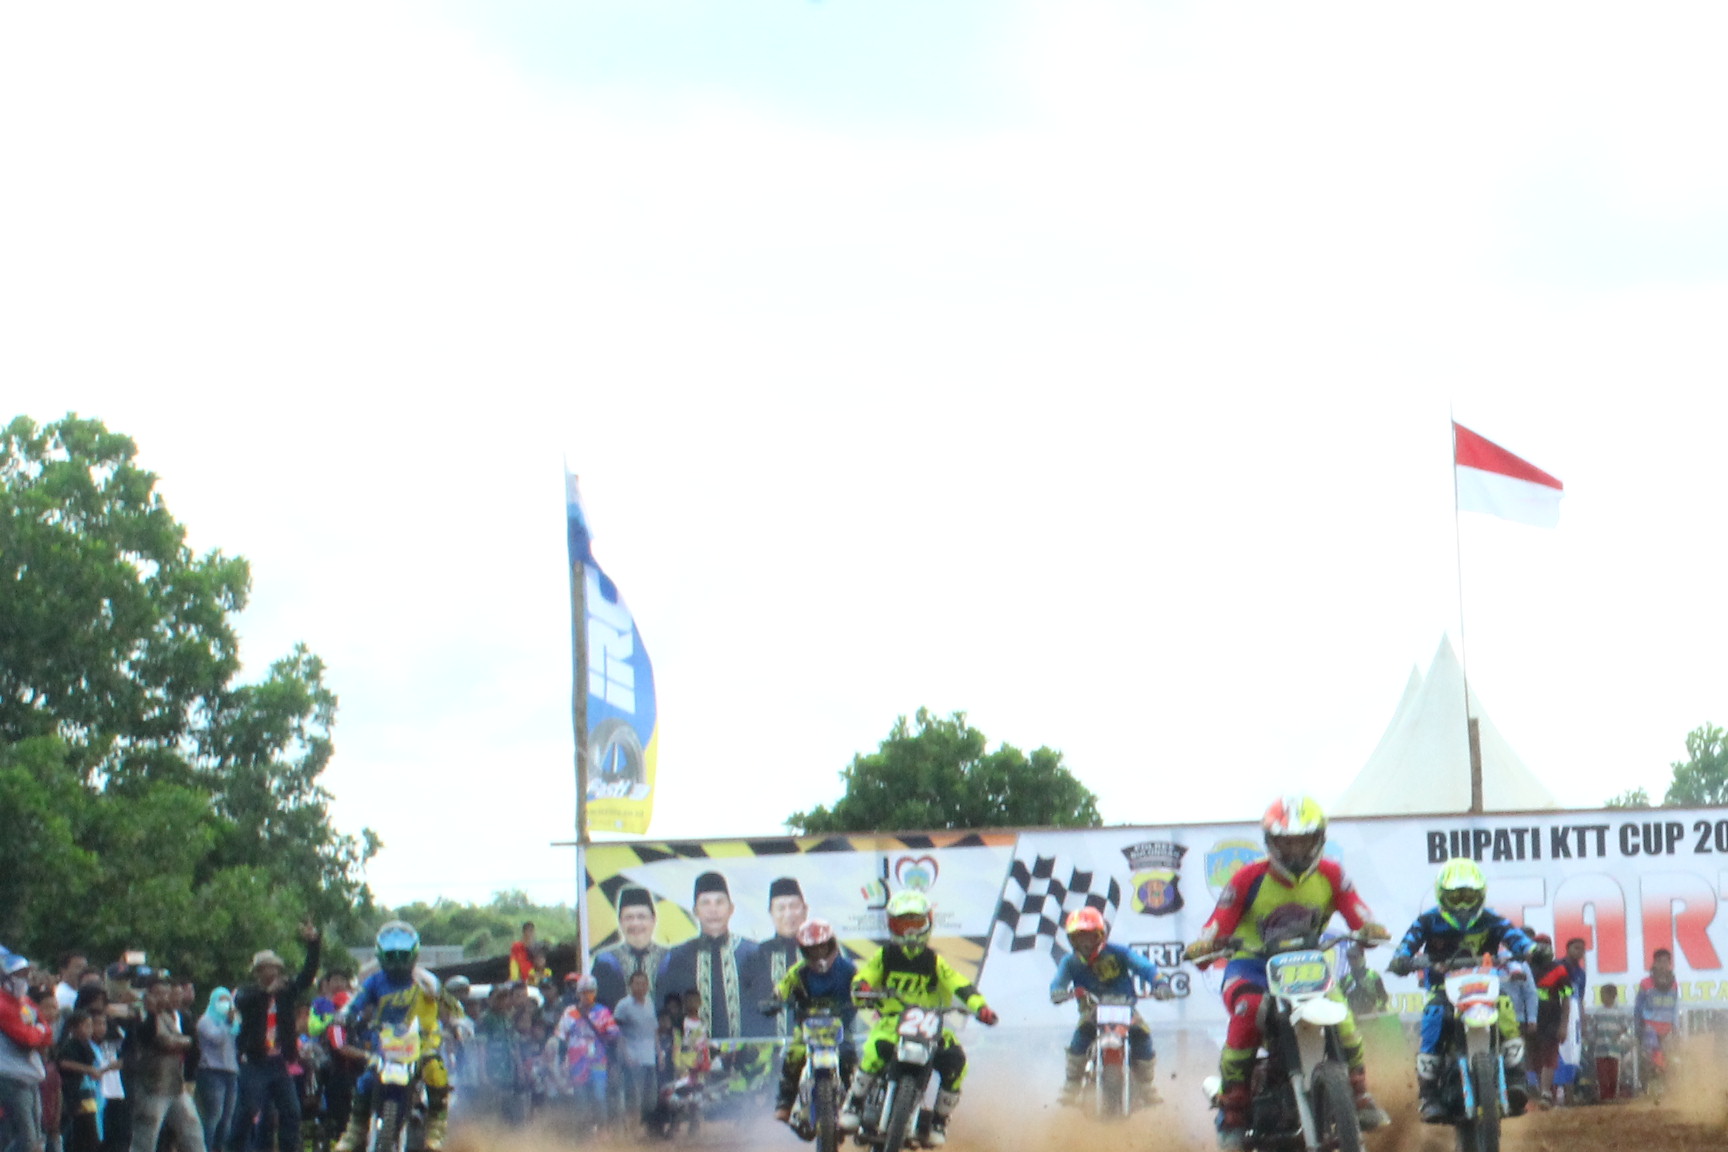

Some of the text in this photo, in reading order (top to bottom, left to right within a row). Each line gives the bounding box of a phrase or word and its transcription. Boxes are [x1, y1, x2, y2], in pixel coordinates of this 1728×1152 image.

[1427, 827, 1541, 863] BUPATI
[1551, 824, 1610, 859] KTT
[1619, 821, 1684, 857] CUP
[898, 1006, 940, 1039] 24
